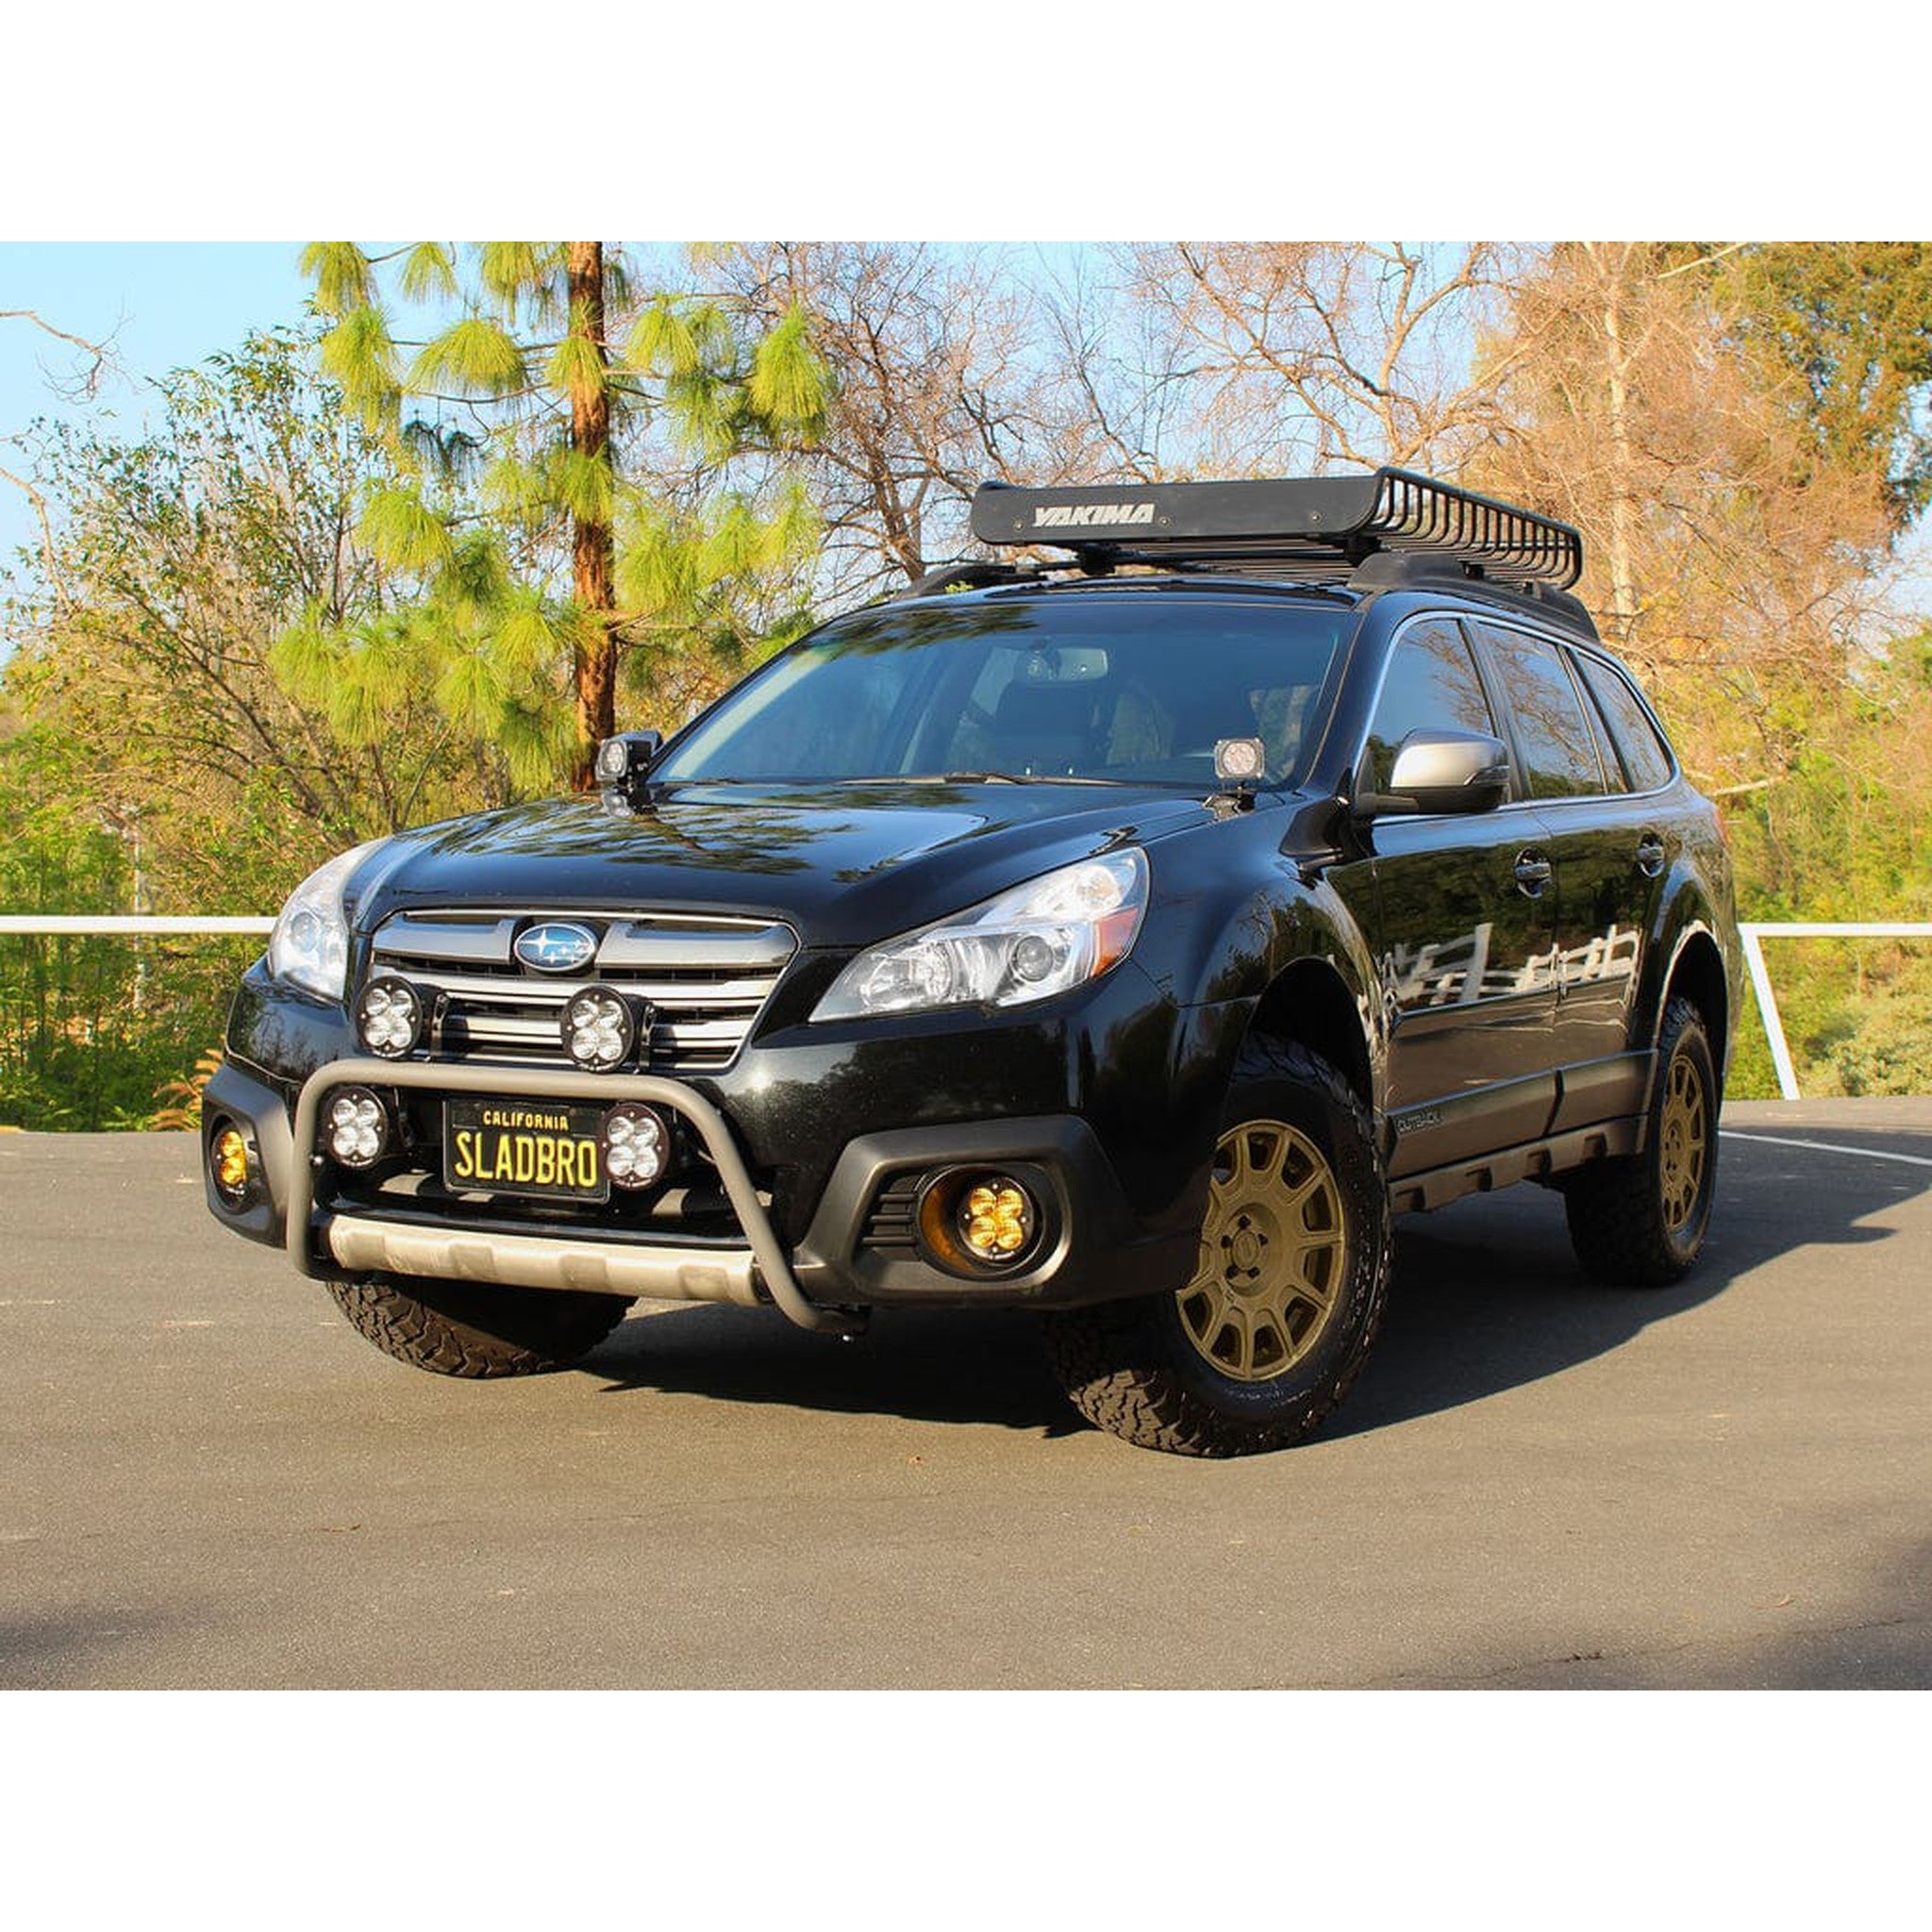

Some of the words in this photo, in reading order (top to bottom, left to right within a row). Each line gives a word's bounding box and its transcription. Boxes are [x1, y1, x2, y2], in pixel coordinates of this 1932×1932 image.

[1032, 503, 1155, 527] YAKIMA
[483, 1110, 569, 1130] CALIFORNIA
[455, 1131, 597, 1188] SLADBRO
